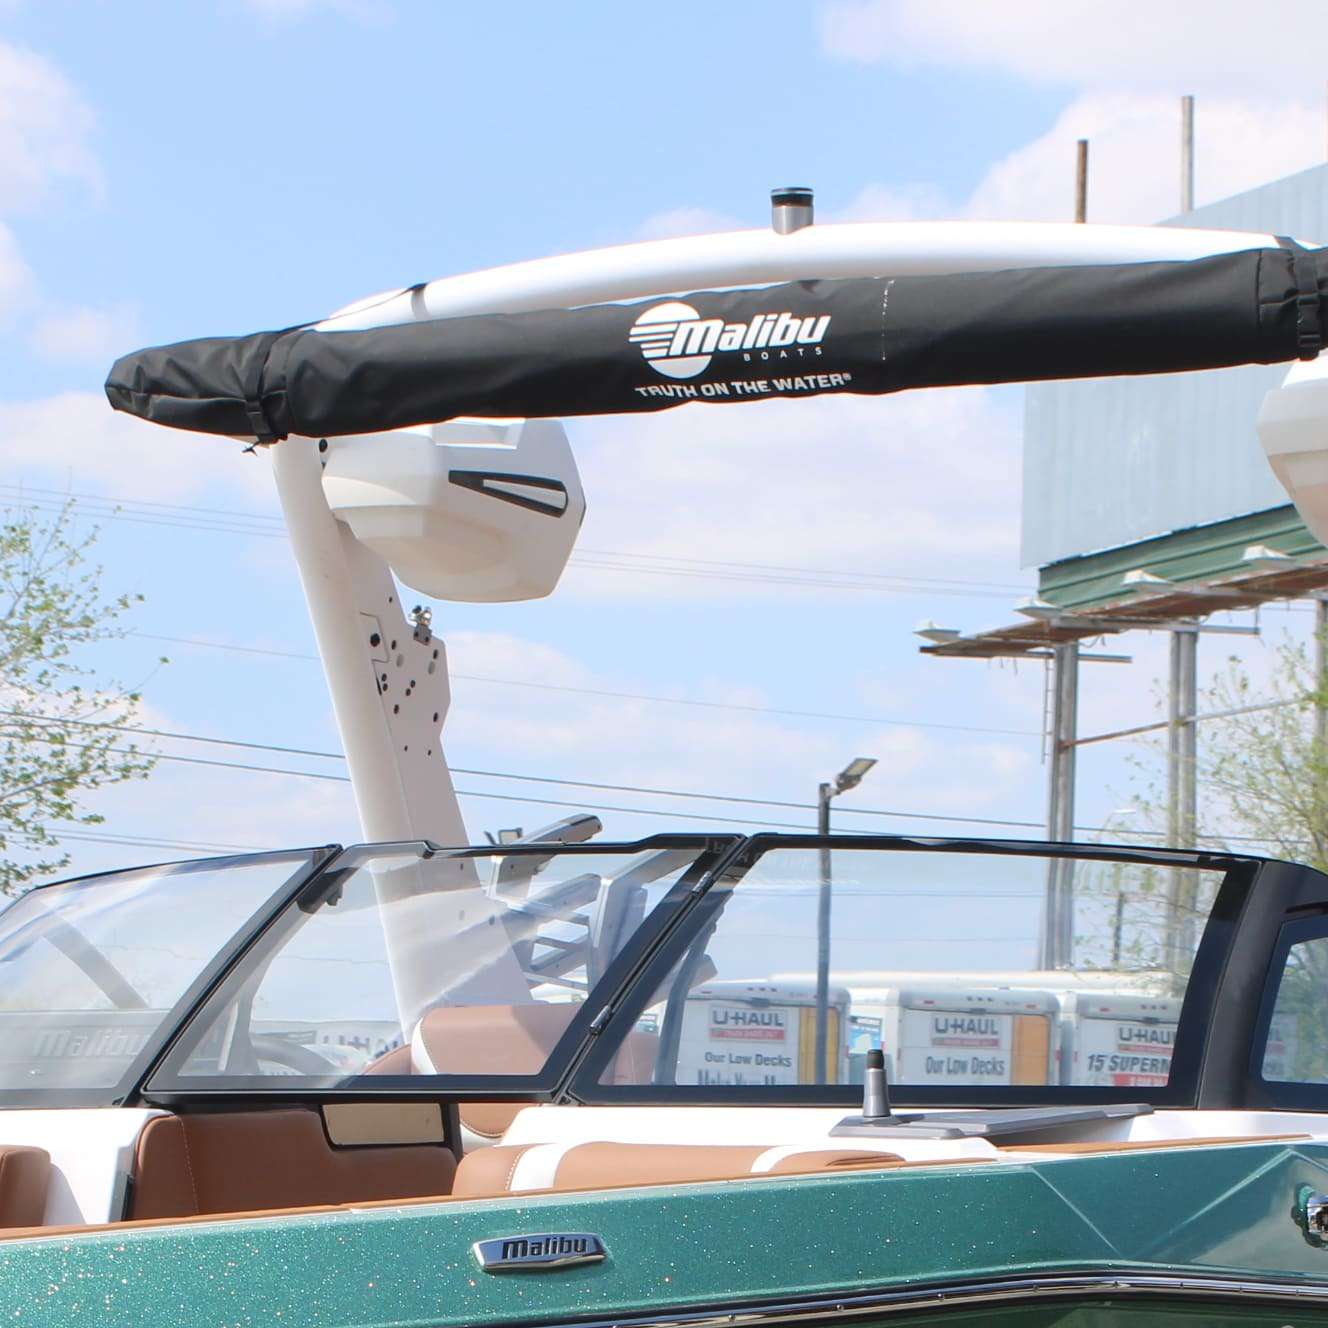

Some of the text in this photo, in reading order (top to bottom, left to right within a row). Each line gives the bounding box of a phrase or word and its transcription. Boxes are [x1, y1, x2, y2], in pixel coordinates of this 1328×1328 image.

[669, 312, 832, 356] Malibu
[744, 347, 823, 362] BOATS
[634, 384, 697, 399] TRUTH
[701, 382, 728, 397] ON
[730, 379, 771, 395] THE
[704, 1051, 793, 1067] Our Low Decks
[926, 1056, 1005, 1076] Our Low Decks
[501, 1236, 587, 1260] Malibu
